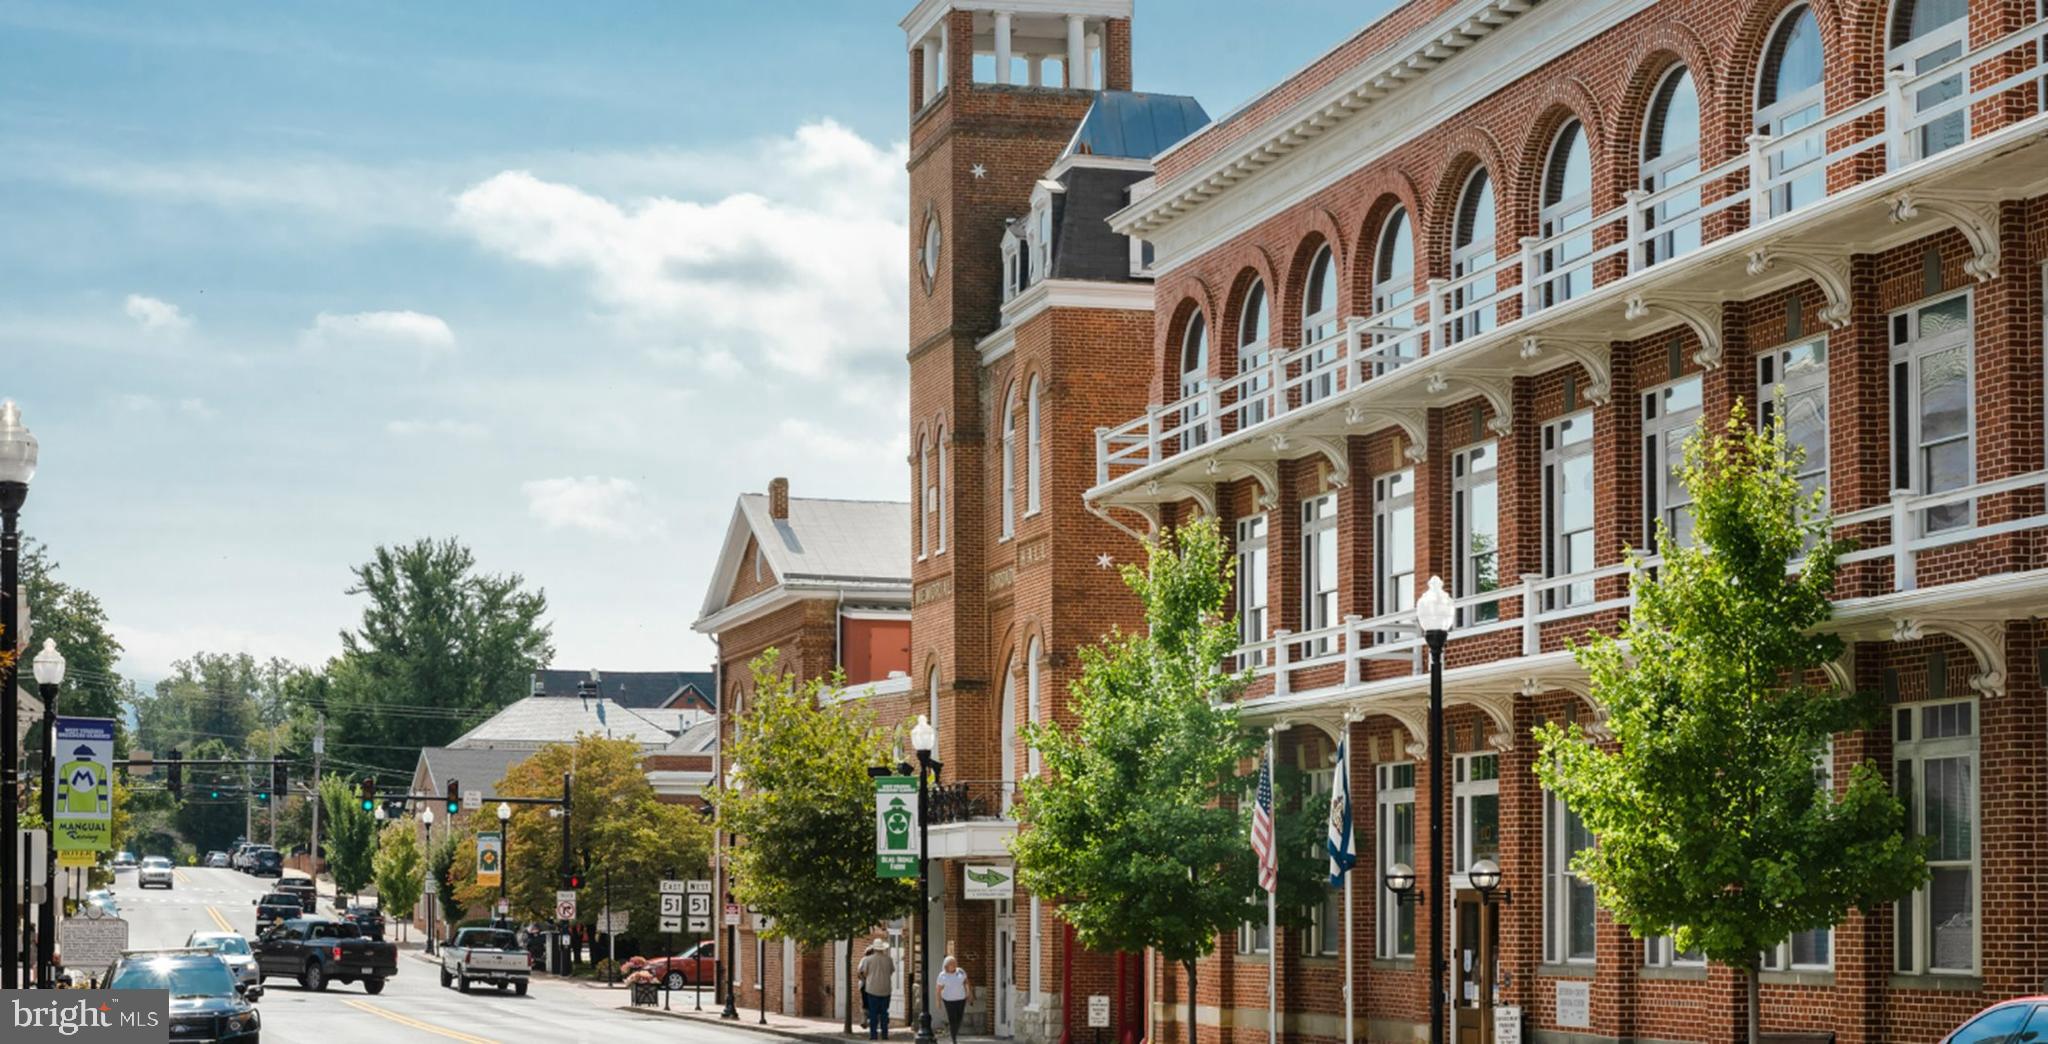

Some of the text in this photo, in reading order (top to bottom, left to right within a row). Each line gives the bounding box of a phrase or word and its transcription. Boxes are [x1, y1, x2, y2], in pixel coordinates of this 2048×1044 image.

[72, 770, 94, 787] M
[662, 882, 682, 890] EAST
[664, 898, 680, 912] 51
[692, 898, 708, 912] 51
